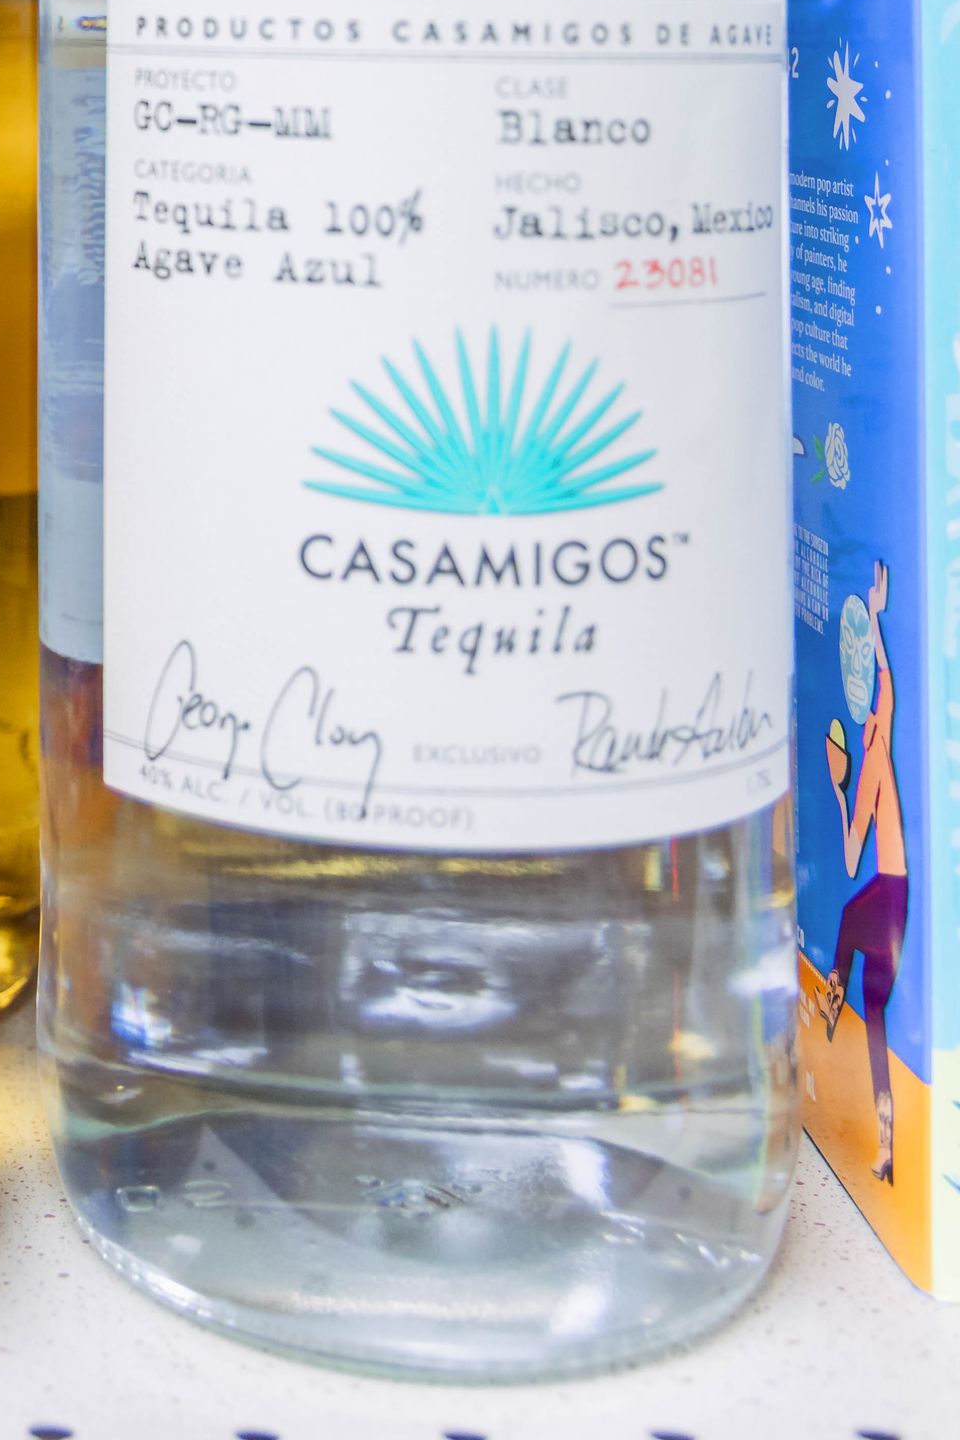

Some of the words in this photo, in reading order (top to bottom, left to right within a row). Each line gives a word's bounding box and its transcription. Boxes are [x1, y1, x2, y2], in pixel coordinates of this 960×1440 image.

[136, 17, 360, 42] PRODUCTOS
[392, 19, 632, 46] CASAMIGOS
[655, 23, 690, 46] DE
[710, 23, 772, 47] AGAVE
[134, 67, 238, 92] PROYECTO
[494, 76, 569, 100] CLASE
[498, 109, 651, 146] Blanco
[133, 158, 252, 185] CATEGORIA
[494, 171, 582, 195] HECHO
[816, 177, 831, 198] pop
[833, 178, 854, 198] artist
[133, 190, 290, 235] Tequila
[324, 186, 424, 246] 100%
[493, 206, 679, 243] Jalisco,
[691, 203, 774, 236] Mexico
[816, 197, 828, 218] his
[828, 204, 859, 225] passion
[803, 220, 819, 241] into
[820, 226, 850, 254] striking
[133, 240, 243, 280] Agave
[273, 252, 382, 287] Azul
[493, 267, 601, 292] NUMERO
[614, 256, 719, 290] 23081
[804, 247, 837, 273] painters,
[838, 253, 848, 273] he
[811, 274, 827, 296] age,
[827, 275, 856, 307] finding
[813, 299, 828, 318] and
[829, 302, 855, 328] digital
[805, 320, 831, 343] culture
[832, 328, 849, 351] that
[805, 342, 818, 364] the
[819, 353, 841, 373] world
[842, 357, 852, 378] he
[805, 370, 826, 393] color.
[386, 606, 598, 675] Tequila
[411, 743, 542, 766] EXCLUSIVO
